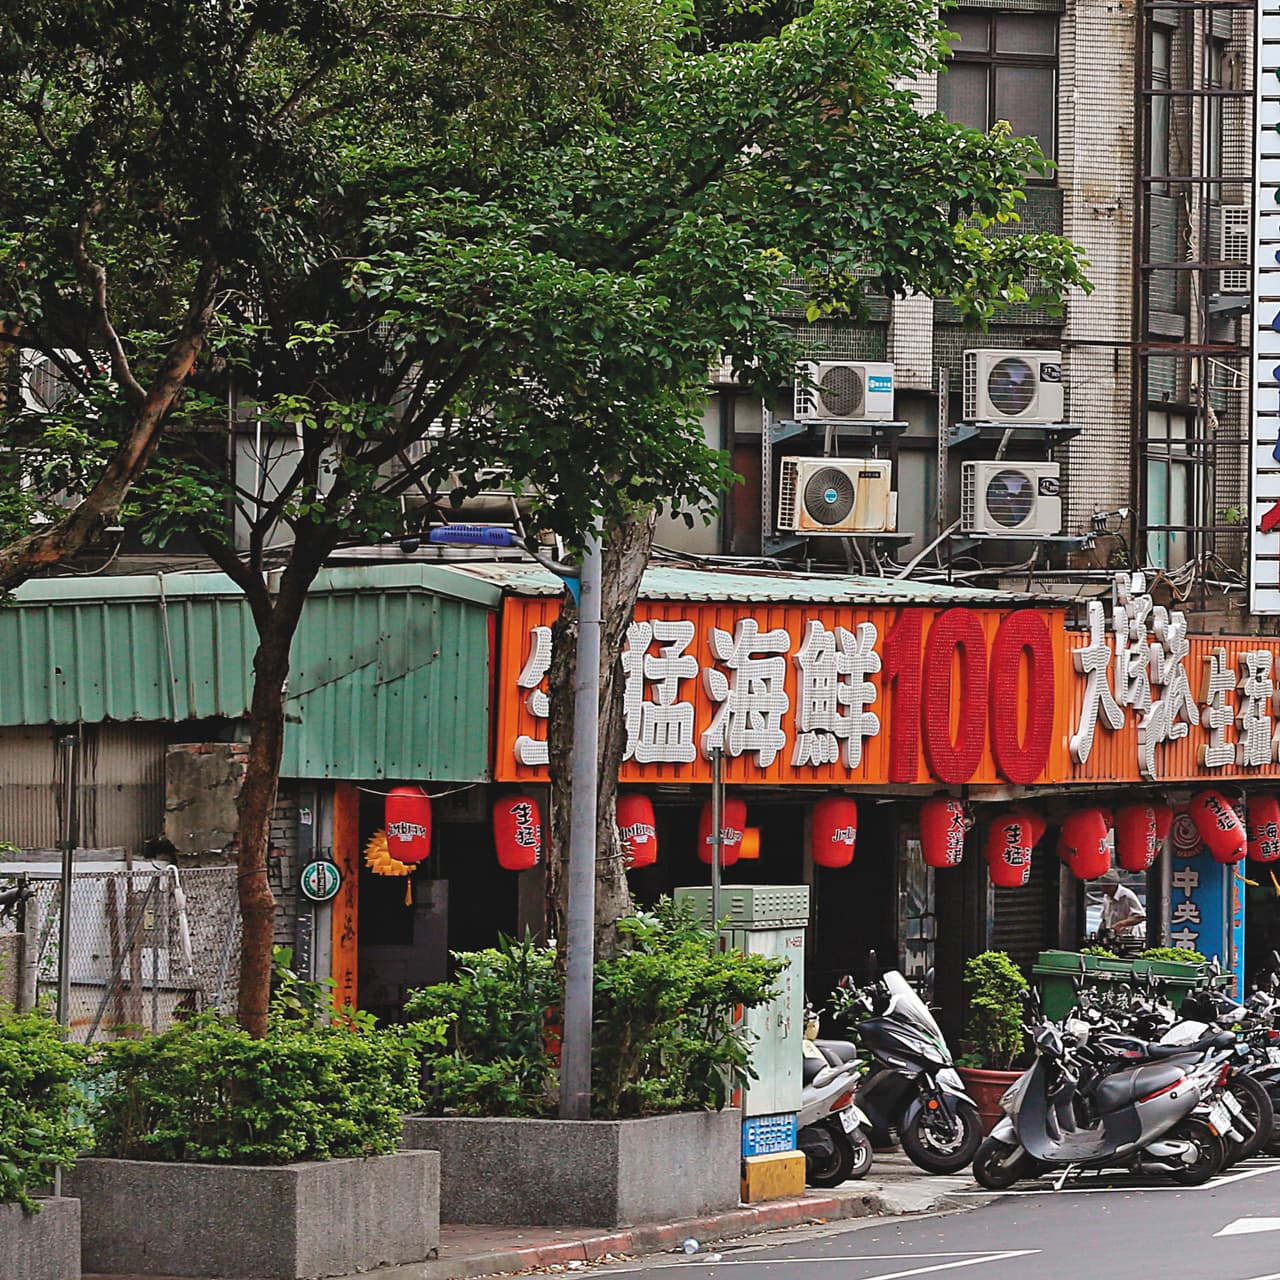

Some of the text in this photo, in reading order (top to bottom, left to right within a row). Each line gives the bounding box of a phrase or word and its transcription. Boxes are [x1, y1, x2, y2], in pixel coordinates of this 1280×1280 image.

[880, 607, 1057, 785] 100
[509, 801, 537, 848] 生猛
[1003, 823, 1026, 866] 生猛
